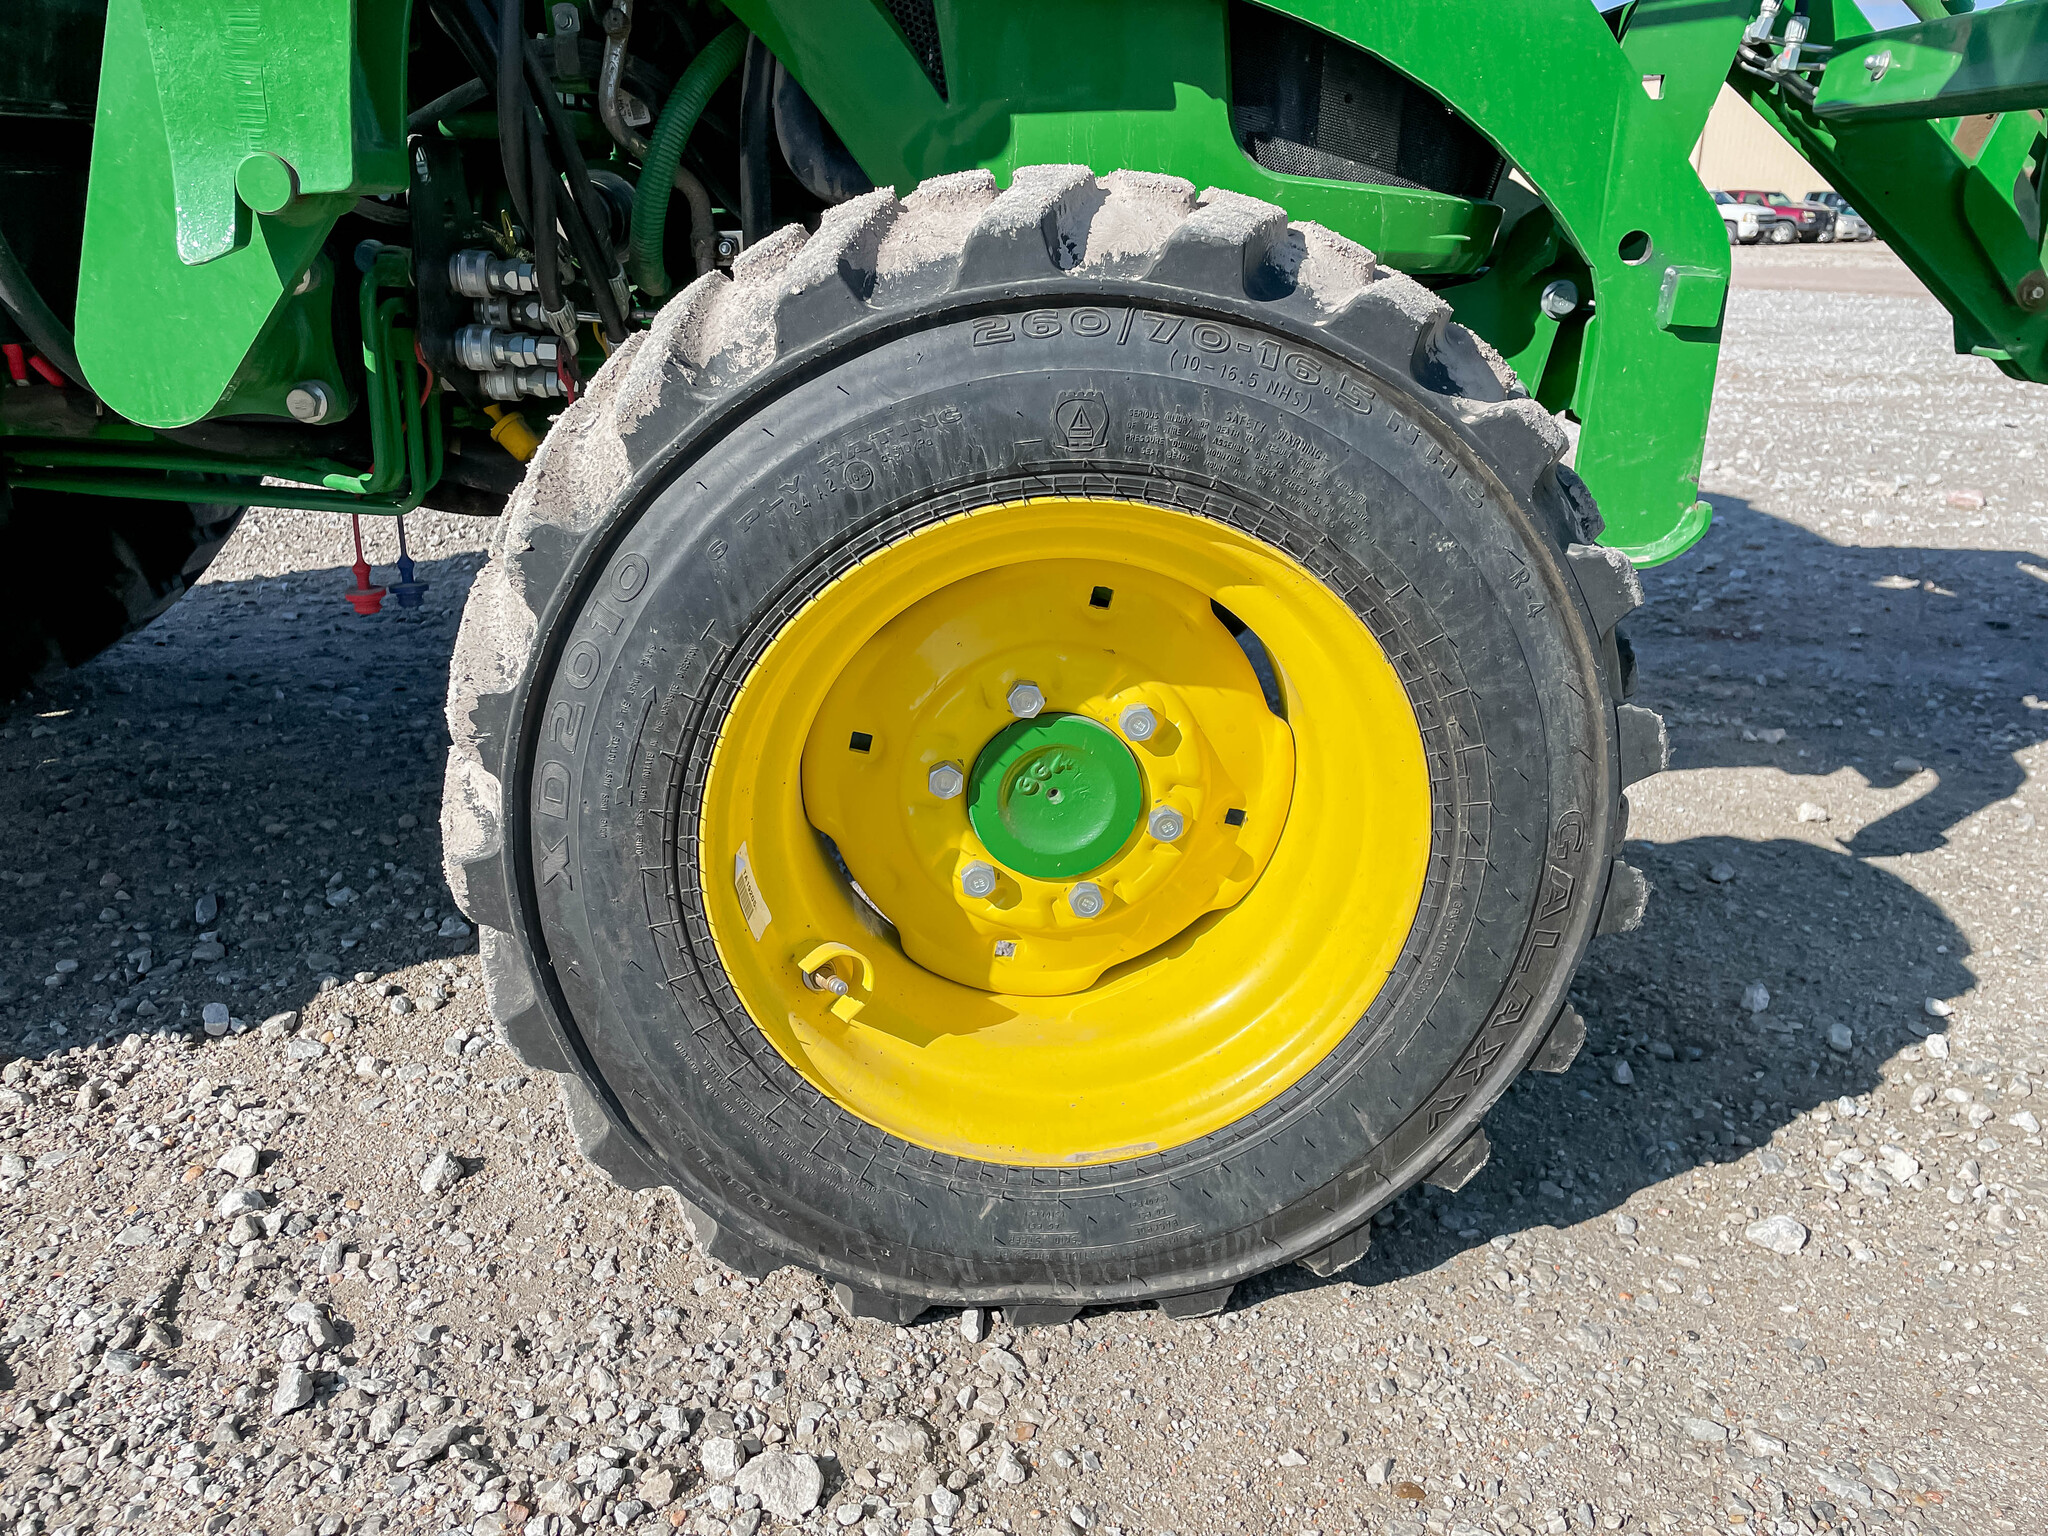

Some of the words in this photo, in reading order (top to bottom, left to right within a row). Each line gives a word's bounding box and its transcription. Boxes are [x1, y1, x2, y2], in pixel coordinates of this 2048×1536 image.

[971, 307, 1376, 414] 260/70-16.5
[1386, 411, 1485, 509] NHS
[1168, 350, 1259, 388] (10-16.5
[1265, 378, 1313, 415] NHS)
[1125, 432, 1166, 445] PRESSURE
[1170, 439, 1201, 452] DURING
[1126, 420, 1137, 429] OF
[1142, 422, 1159, 432] THE
[1128, 407, 1160, 420] SERIOUS
[1214, 423, 1241, 438] DEATH
[1224, 410, 1267, 432] SAFETY
[736, 474, 805, 533] PLY
[817, 406, 963, 473] RATING
[1123, 444, 1134, 453] TO
[1139, 446, 1161, 457] SEAT
[1508, 567, 1547, 620] R-4
[538, 552, 650, 891] XD2010
[1424, 810, 1586, 1133] GALAXY
